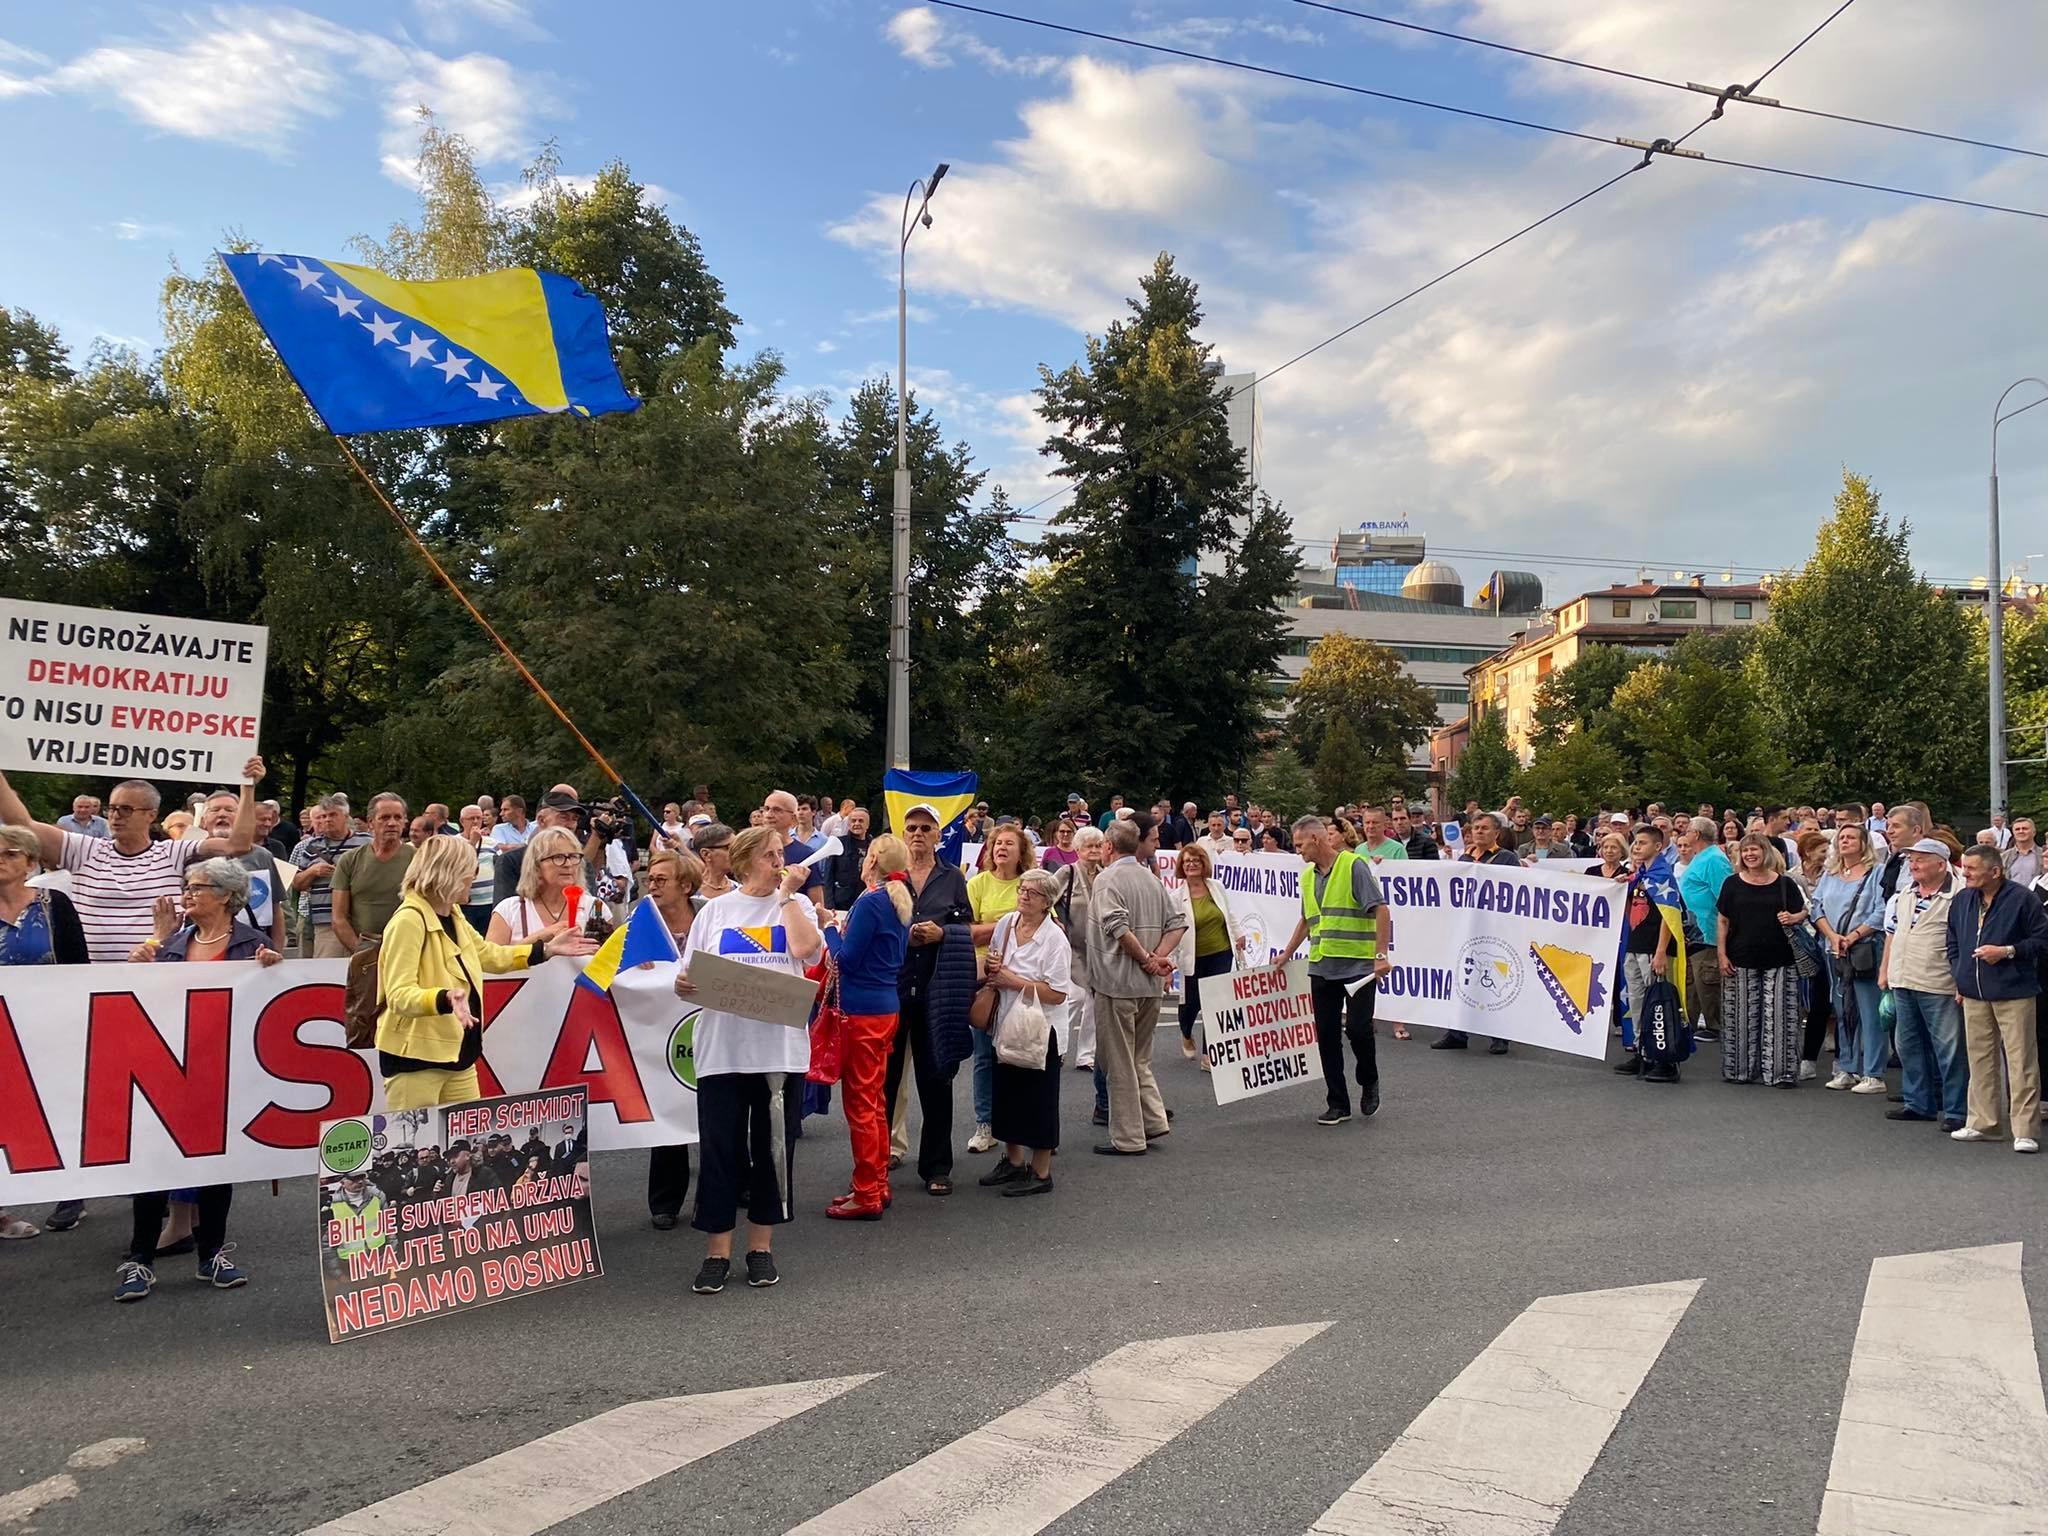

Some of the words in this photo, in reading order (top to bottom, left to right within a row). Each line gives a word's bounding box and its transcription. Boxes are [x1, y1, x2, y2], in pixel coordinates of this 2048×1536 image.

[1380, 521, 1409, 529] BANKA
[8, 617, 49, 643] NE
[57, 623, 253, 664] UGROŽAVAJTE
[27, 658, 229, 698] DEMOKRATIJU
[34, 699, 103, 726] NISU
[111, 705, 256, 739] EVROPSKE
[27, 738, 213, 773] VRIJEDNOSTI
[1265, 869, 1277, 895] ZA
[1450, 877, 1610, 928] GRAĐANSKA
[1233, 969, 1287, 1000] NEĆEMO
[1216, 1007, 1245, 1034] VAM
[1246, 993, 1314, 1027] DOZVOLITI
[1653, 1005, 1666, 1050] adidas
[1209, 1038, 1241, 1067] OPET
[1242, 1054, 1308, 1090] RJEŠENJE
[448, 1107, 492, 1137] HER
[495, 1093, 585, 1130] SCHMIDT
[326, 1139, 367, 1154] ReSTART
[373, 1137, 385, 1147] 50
[328, 1217, 366, 1247] BIH
[373, 1208, 397, 1240] JE
[401, 1187, 510, 1233] SUVERENA
[512, 1171, 584, 1208] DRŽAVA
[349, 1233, 446, 1281] IMAJTE
[449, 1227, 480, 1258] TO
[485, 1219, 521, 1250] NA
[523, 1206, 575, 1241] UMU
[335, 1265, 476, 1333] NEDAMO
[481, 1238, 595, 1297] BOSNU!
